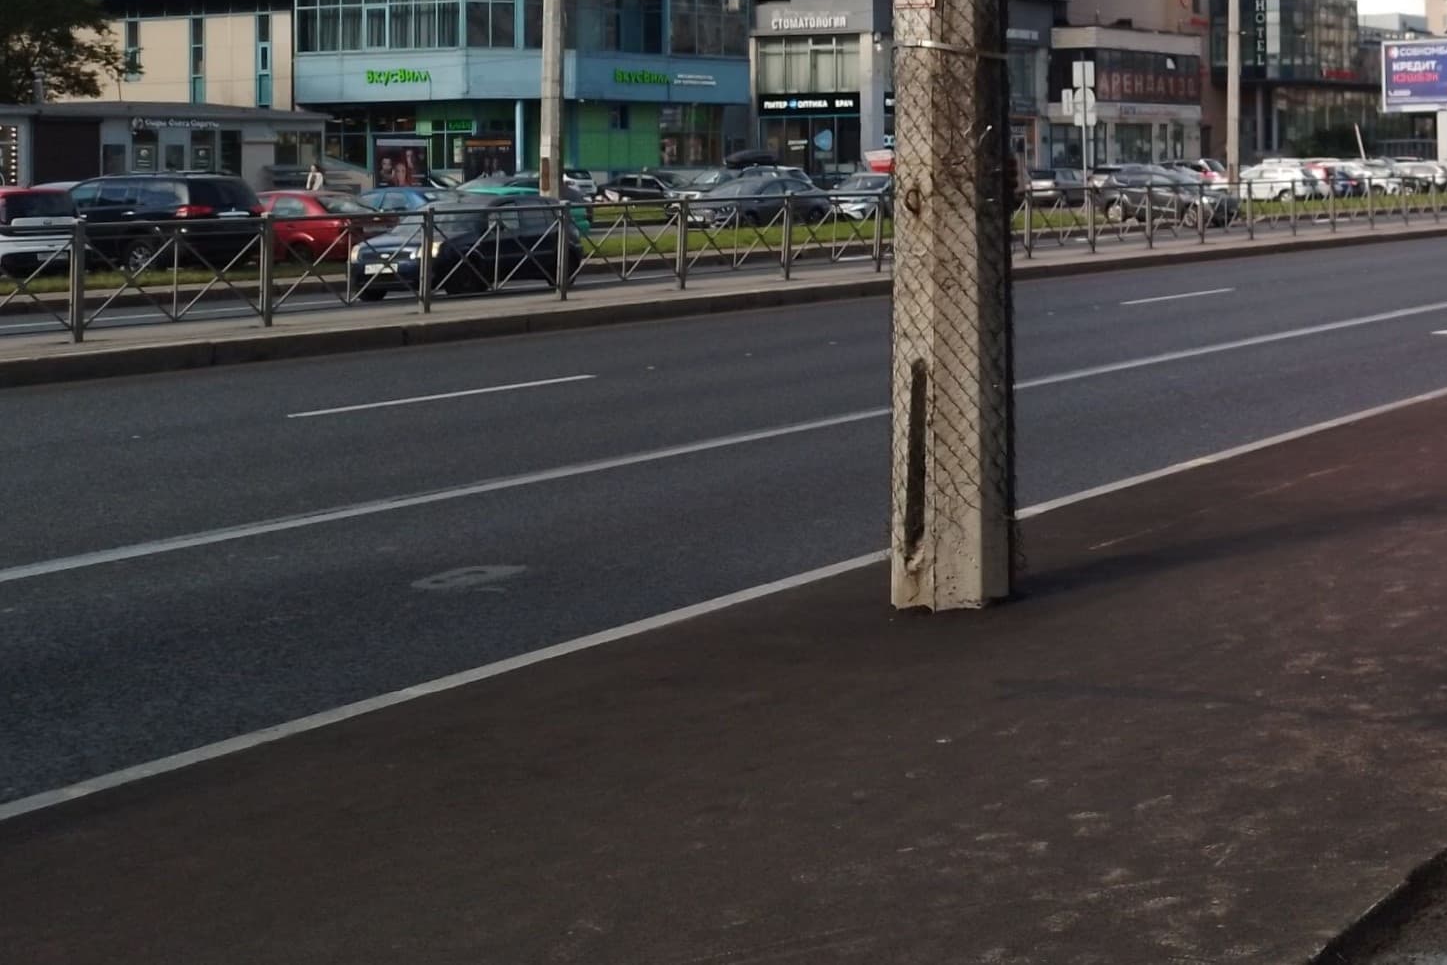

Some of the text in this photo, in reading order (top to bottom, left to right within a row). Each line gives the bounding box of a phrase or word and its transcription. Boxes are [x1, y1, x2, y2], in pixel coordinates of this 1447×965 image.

[771, 15, 847, 30] СТОМАТОЛОГИЯ
[1255, 0, 1265, 66] HOTEL
[1392, 60, 1437, 71] КРЕДИТ
[763, 100, 788, 109] ПИТЕР
[797, 99, 829, 108] ОПТИКА
